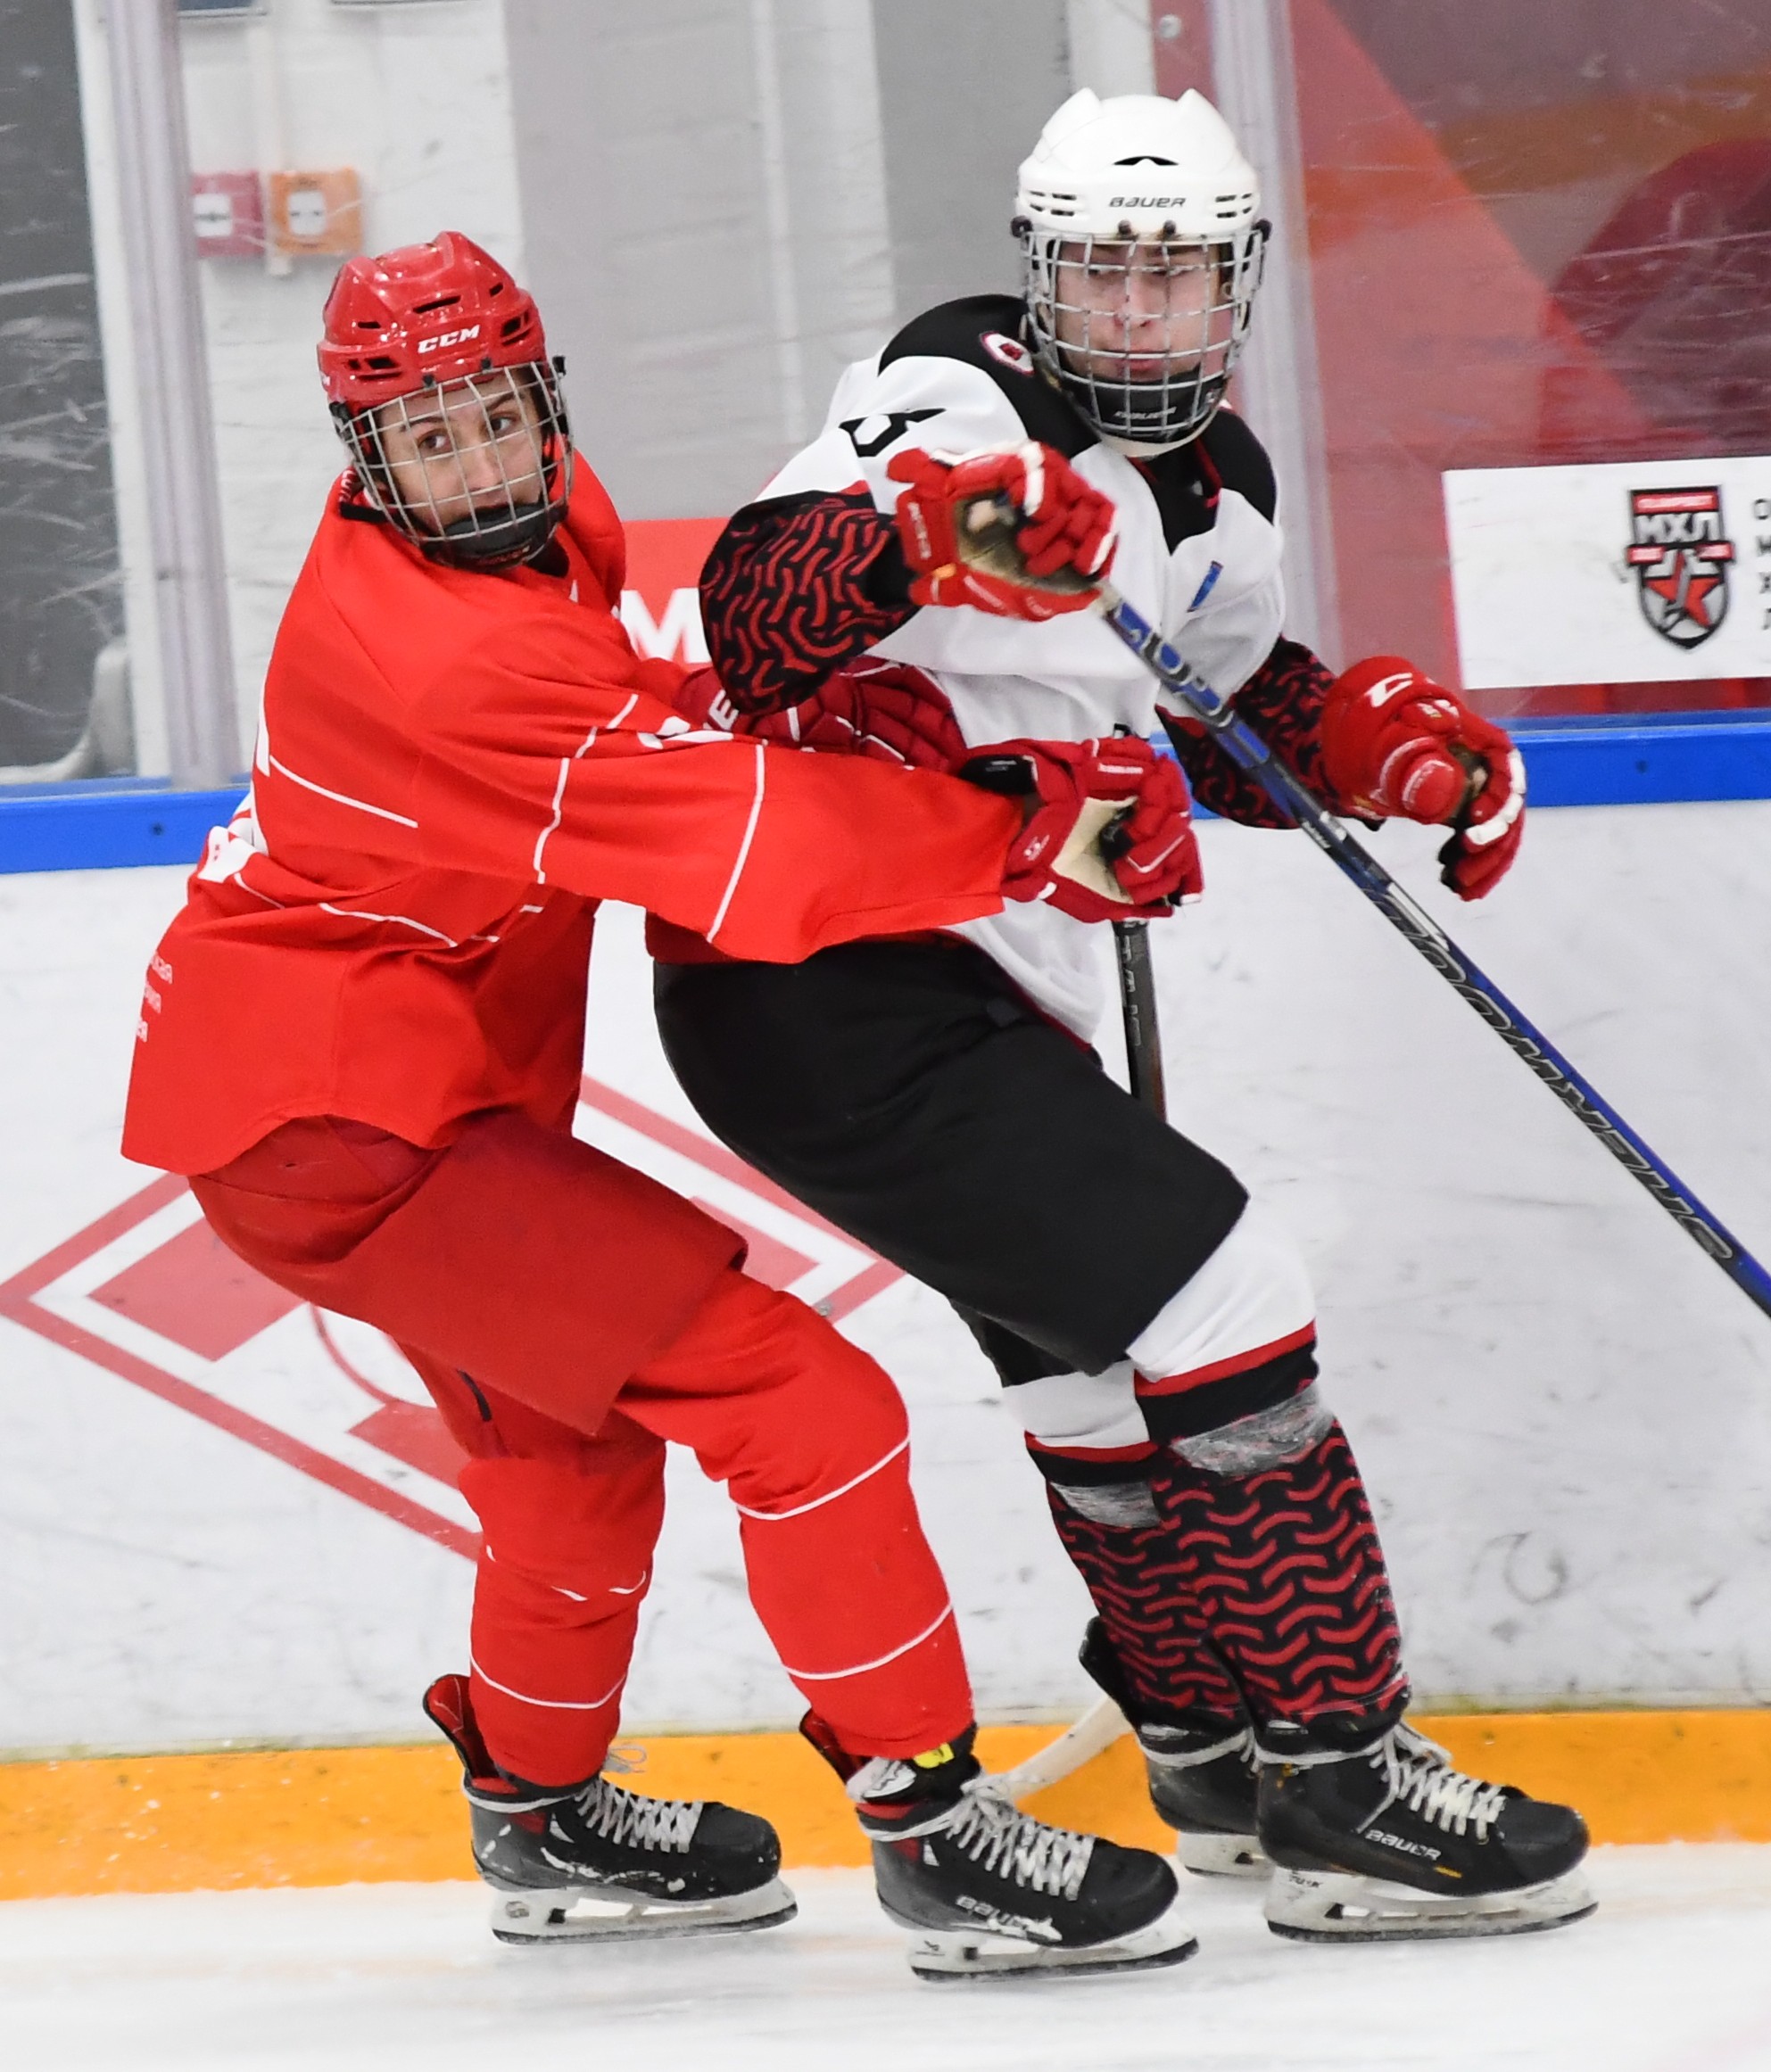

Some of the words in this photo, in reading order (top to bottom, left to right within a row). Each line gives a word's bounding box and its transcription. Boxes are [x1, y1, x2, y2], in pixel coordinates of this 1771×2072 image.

[1109, 196, 1187, 209] BAUER
[417, 324, 480, 354] CCM
[1634, 511, 1721, 544] МХЛ
[1365, 1829, 1442, 1861] BAUER
